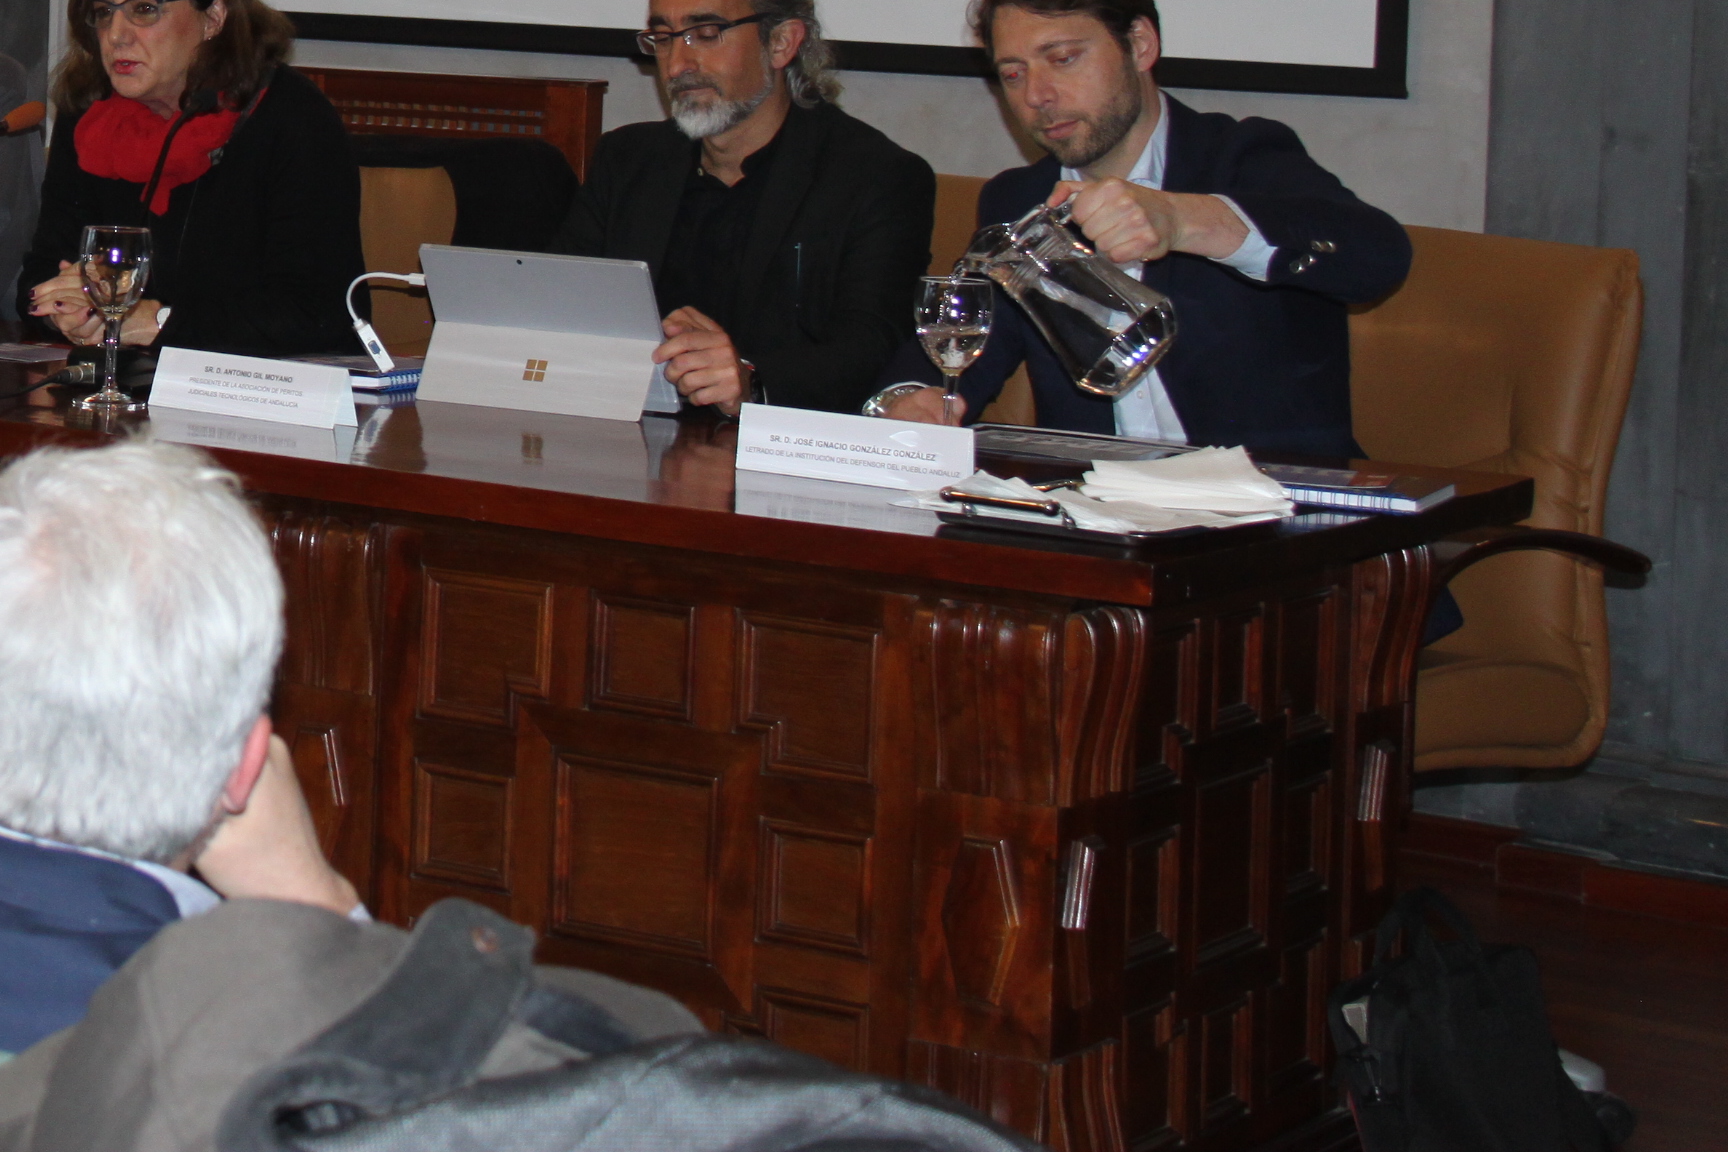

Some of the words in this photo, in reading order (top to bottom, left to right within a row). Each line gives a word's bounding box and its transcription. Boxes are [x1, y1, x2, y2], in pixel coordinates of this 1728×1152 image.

[204, 366, 214, 374] SR.
[224, 369, 252, 378] ANTONIO
[253, 371, 263, 380] GIL
[265, 373, 293, 383] MOYANO
[188, 388, 217, 398] JUDICIALES
[218, 392, 259, 403] TECNOLÓGICOS
[189, 377, 221, 386] PRESIDENTE
[222, 380, 229, 388] DE
[238, 383, 270, 392] ASOCIACIÓN
[280, 388, 303, 397] PERITOS
[770, 434, 782, 442] SR.
[784, 436, 791, 444] D.
[793, 437, 813, 446] JOSÉ
[815, 440, 847, 450] IGNACIO
[850, 444, 891, 456] GONZÁLEZ
[893, 449, 936, 461] GONZÁLEZ
[745, 446, 774, 455] LETRADO
[775, 449, 784, 457] DE
[795, 452, 835, 462] INSTITUCIÓN
[836, 456, 848, 464] DEL
[850, 458, 885, 469] DEFENSOR
[887, 463, 899, 471] DEL
[901, 464, 927, 475] PUEBLO
[929, 468, 960, 478] ANDALUZ
